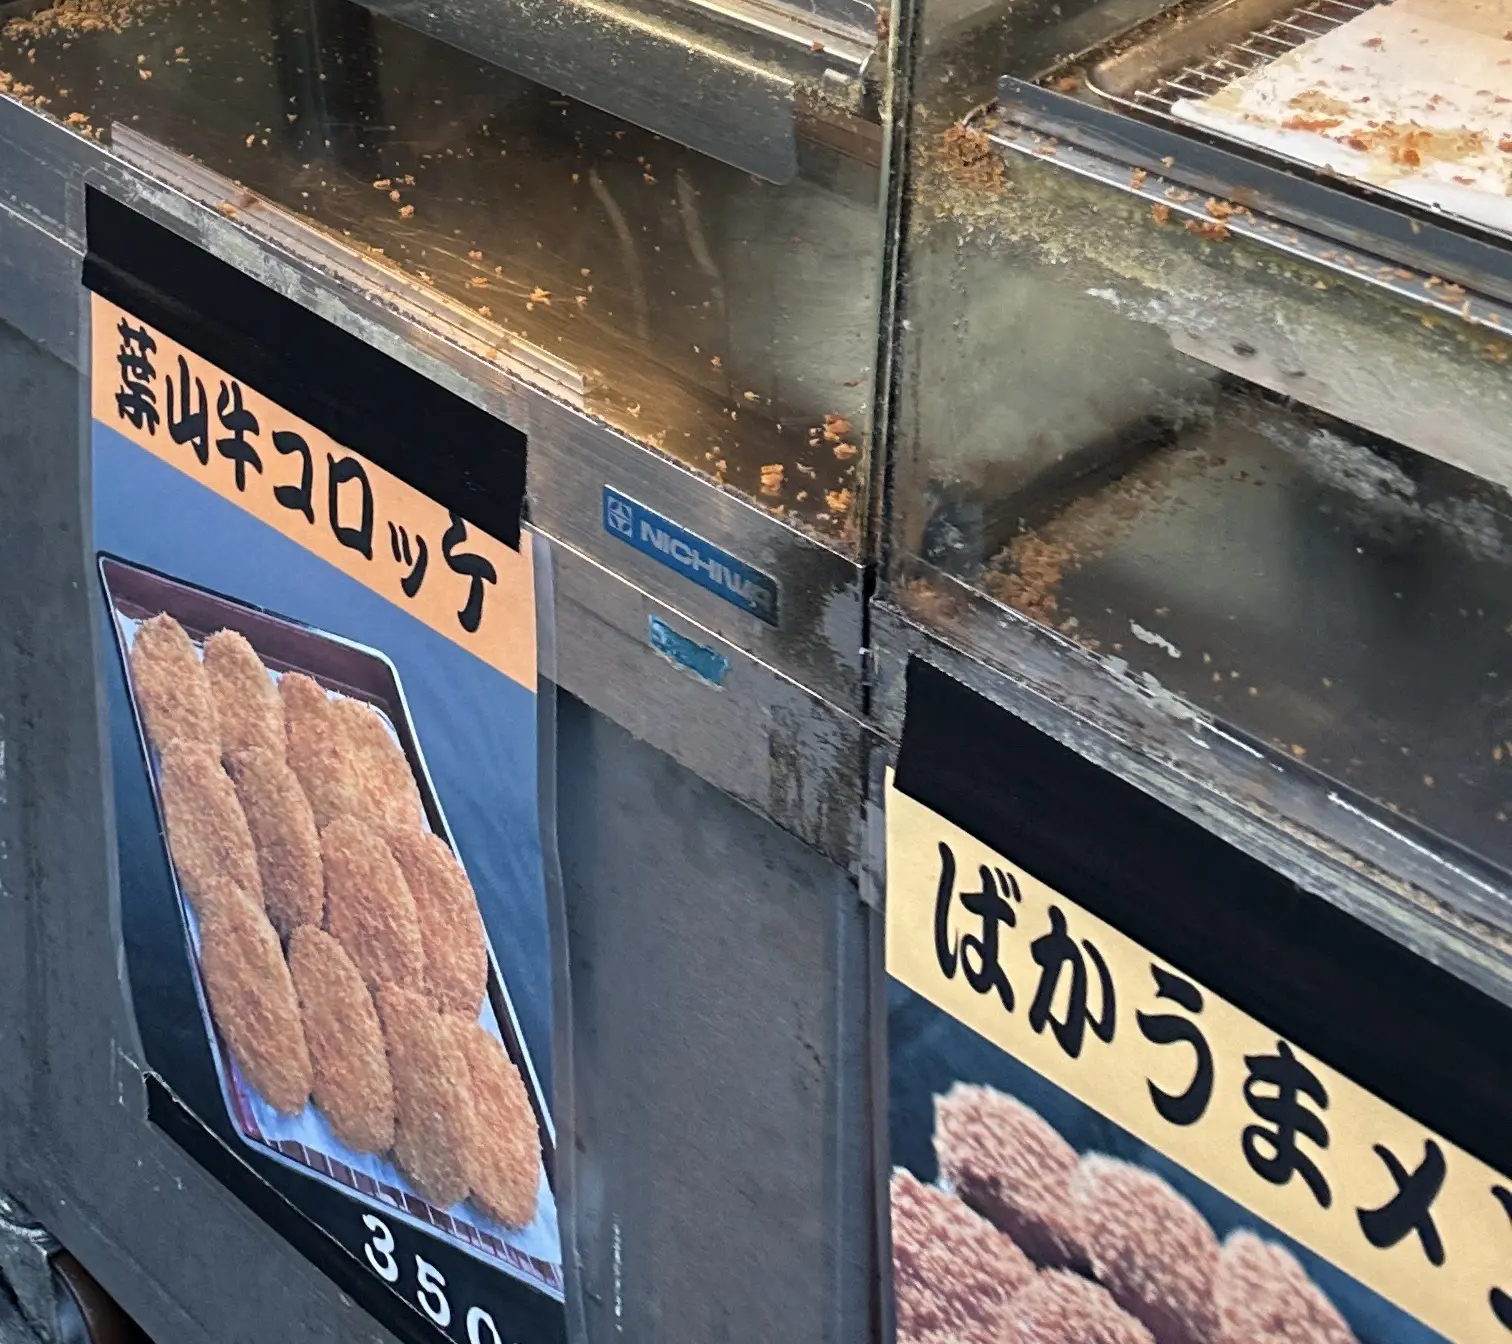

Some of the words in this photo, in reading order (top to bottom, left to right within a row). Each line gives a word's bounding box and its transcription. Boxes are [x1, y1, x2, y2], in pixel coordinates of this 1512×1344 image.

[115, 318, 497, 634] 葉山牛コロッケ
